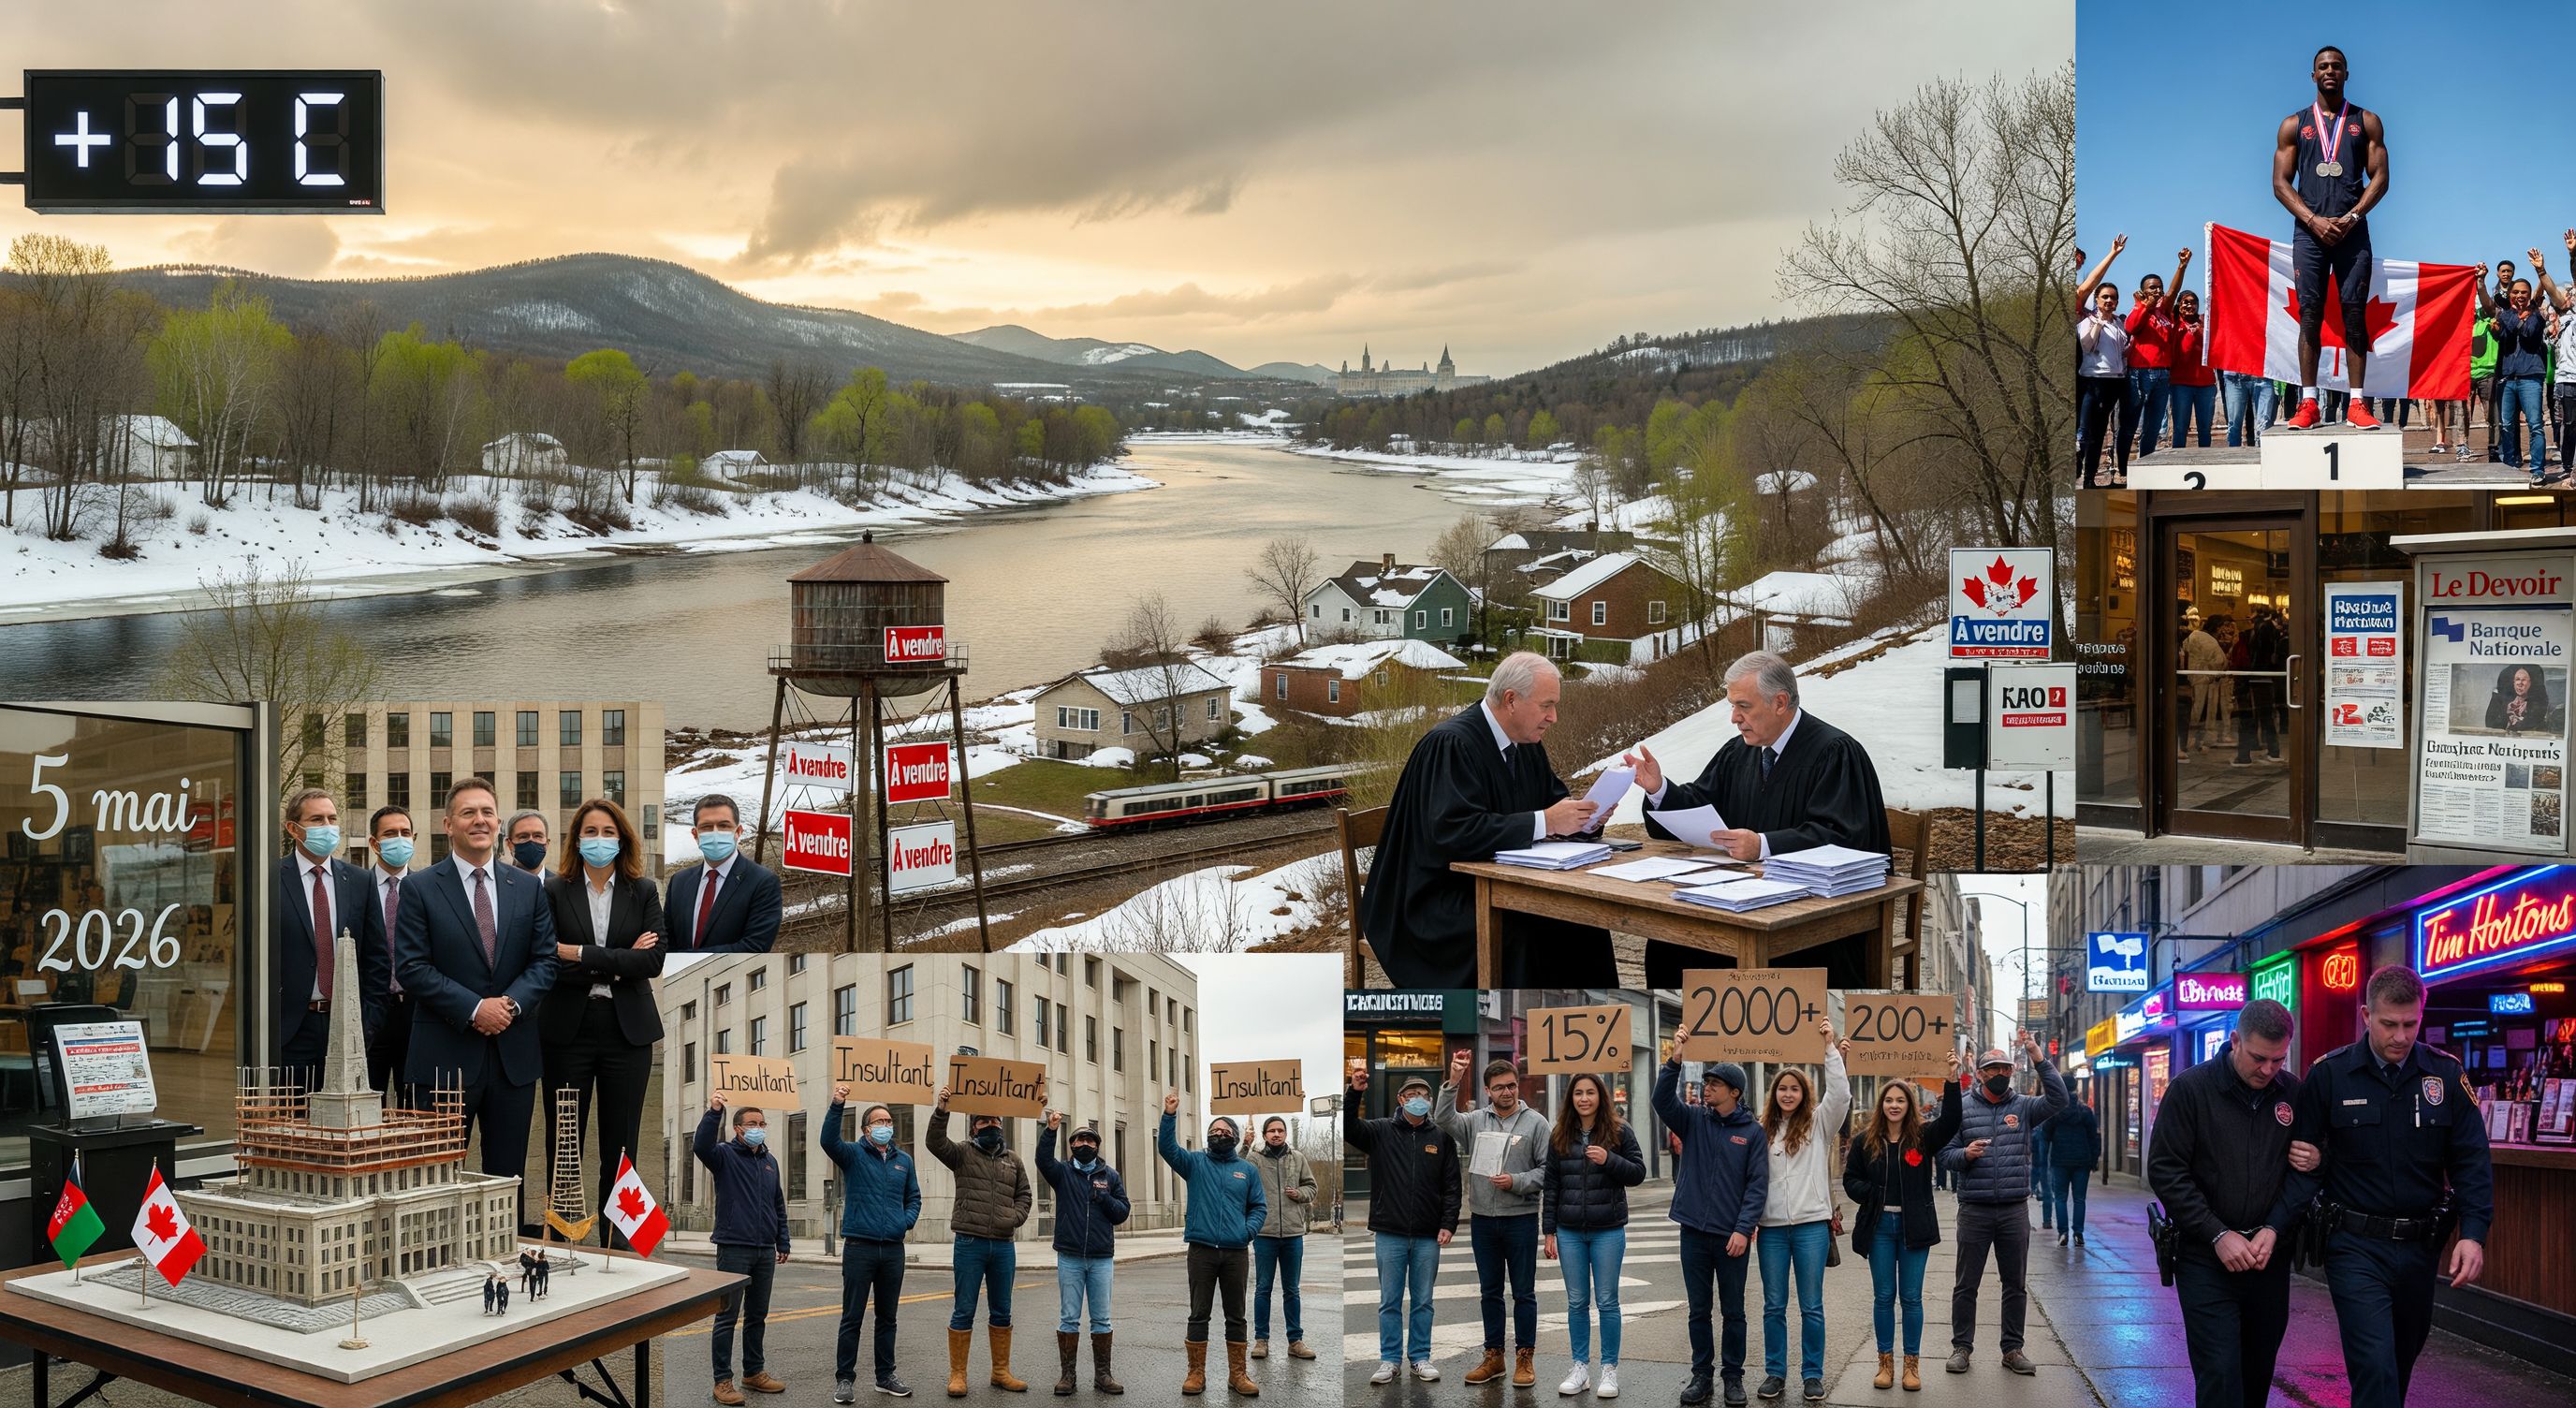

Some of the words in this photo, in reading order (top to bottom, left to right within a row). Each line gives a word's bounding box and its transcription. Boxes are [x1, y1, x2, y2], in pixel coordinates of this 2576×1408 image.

[295, 92, 345, 185] C
[2323, 442, 2339, 480] 1
[2431, 572, 2463, 597] Le
[2466, 568, 2562, 597] Devoir
[888, 629, 900, 657] À
[1955, 616, 1969, 641] À
[1972, 621, 2044, 642] vendre
[788, 748, 798, 775] À
[799, 753, 847, 780] vendre
[890, 750, 900, 787] À
[902, 755, 946, 785] vendre
[22, 753, 69, 841] 5
[91, 777, 198, 833] mai
[786, 815, 797, 852] À
[798, 827, 849, 859] vendre
[893, 837, 903, 873] À
[904, 837, 953, 870] vendre
[37, 902, 183, 973] 2026
[2423, 908, 2466, 967] Tim
[2467, 892, 2575, 955] Hortons
[1690, 986, 1821, 1036] 2000+
[1850, 1004, 1948, 1043] 200+
[1541, 1008, 1623, 1063] 15%
[713, 1061, 796, 1093] Insultant
[835, 1046, 934, 1088] Insultant
[950, 1063, 1045, 1102] Insultant
[1212, 1066, 1302, 1099] Insultant
